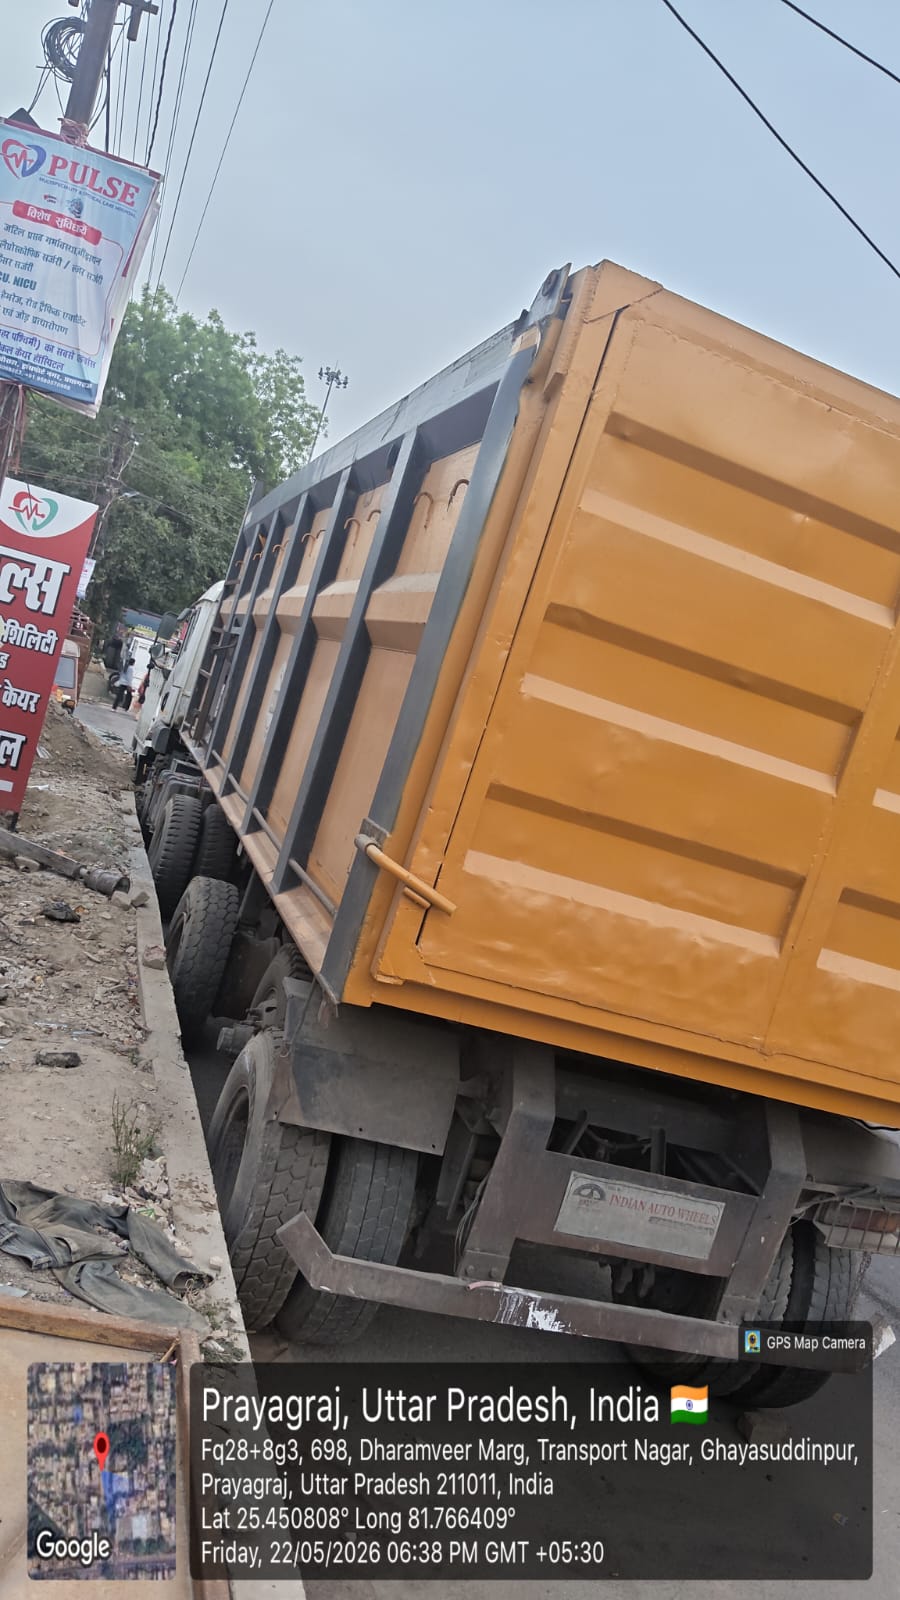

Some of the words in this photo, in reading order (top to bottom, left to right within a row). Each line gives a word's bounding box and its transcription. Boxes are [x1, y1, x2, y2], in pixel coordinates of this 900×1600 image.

[48, 154, 140, 207] PULSE
[12, 275, 37, 291] NICU
[2, 678, 41, 713] केयर
[609, 1194, 646, 1211] INDIAN
[649, 1202, 676, 1217] AUTO
[678, 1207, 717, 1226] WHEELS
